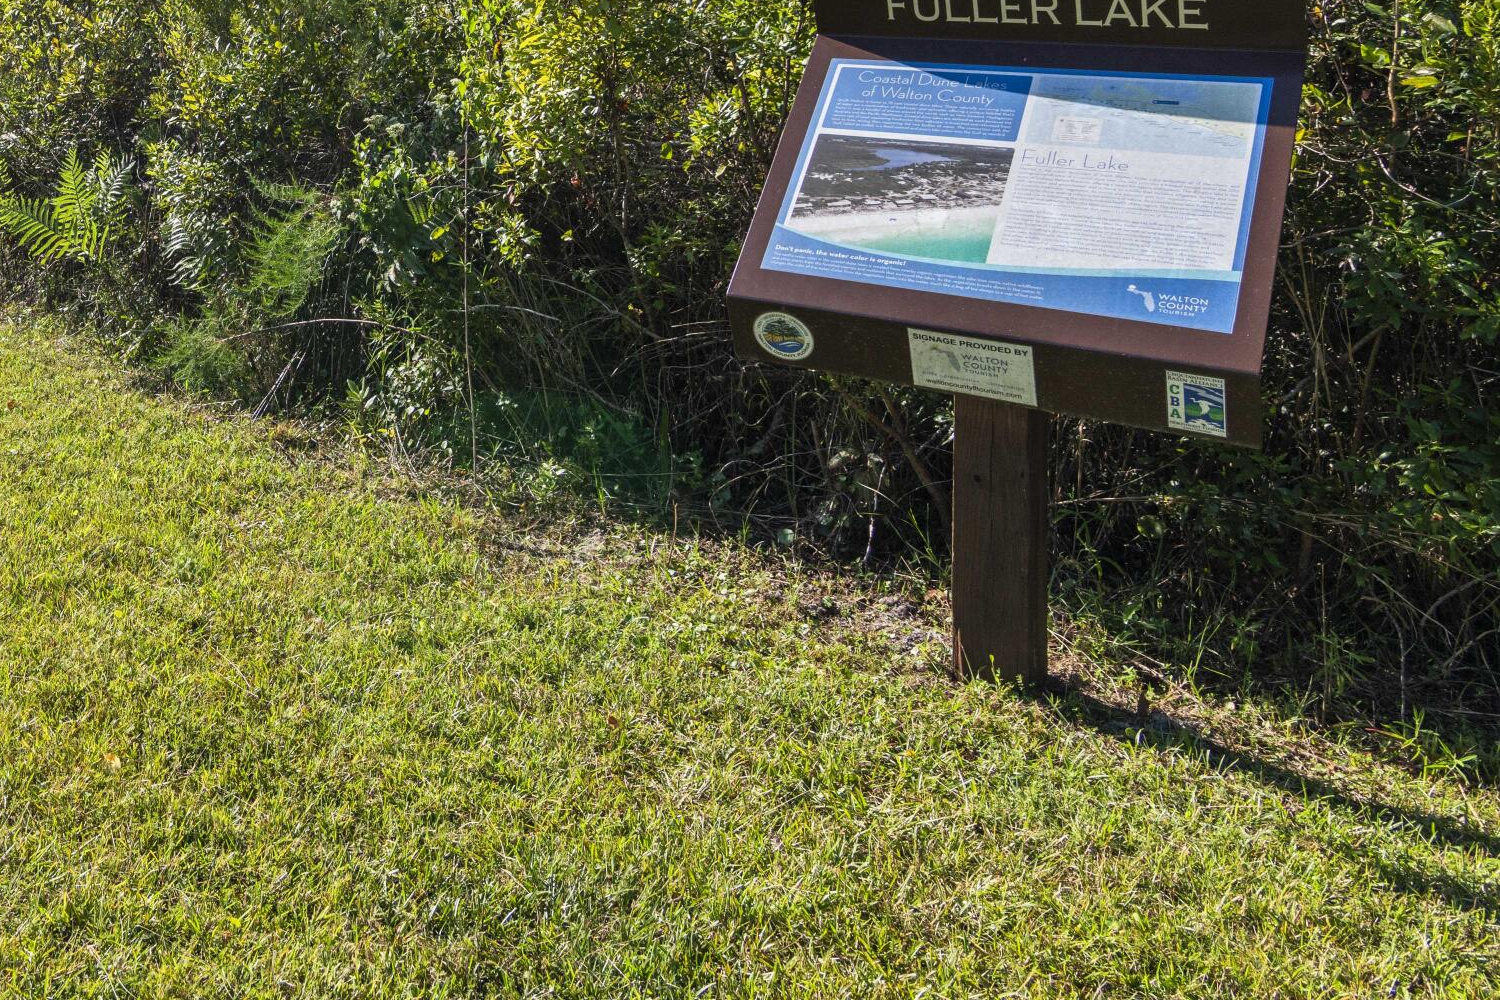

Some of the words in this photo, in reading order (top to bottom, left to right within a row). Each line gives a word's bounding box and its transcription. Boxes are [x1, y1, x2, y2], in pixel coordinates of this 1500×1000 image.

[858, 70, 915, 85] Coastal
[918, 73, 959, 88] Dune
[964, 75, 1008, 90] Lakes
[861, 85, 878, 97] of
[881, 86, 932, 101] Walton
[937, 89, 995, 106] County
[1021, 148, 1075, 167] Fuller
[1083, 153, 1129, 172] Lake
[1158, 293, 1209, 305] WALTON
[1158, 301, 1207, 313] COUNTY
[1158, 308, 1195, 317] TOURISM
[912, 332, 957, 346] SIGNAGE
[958, 340, 1012, 354] PROVIDED
[1014, 348, 1028, 357] BY
[961, 353, 1008, 366] WALTON
[963, 361, 1008, 375] COUNTY
[964, 368, 999, 379] TOURISM
